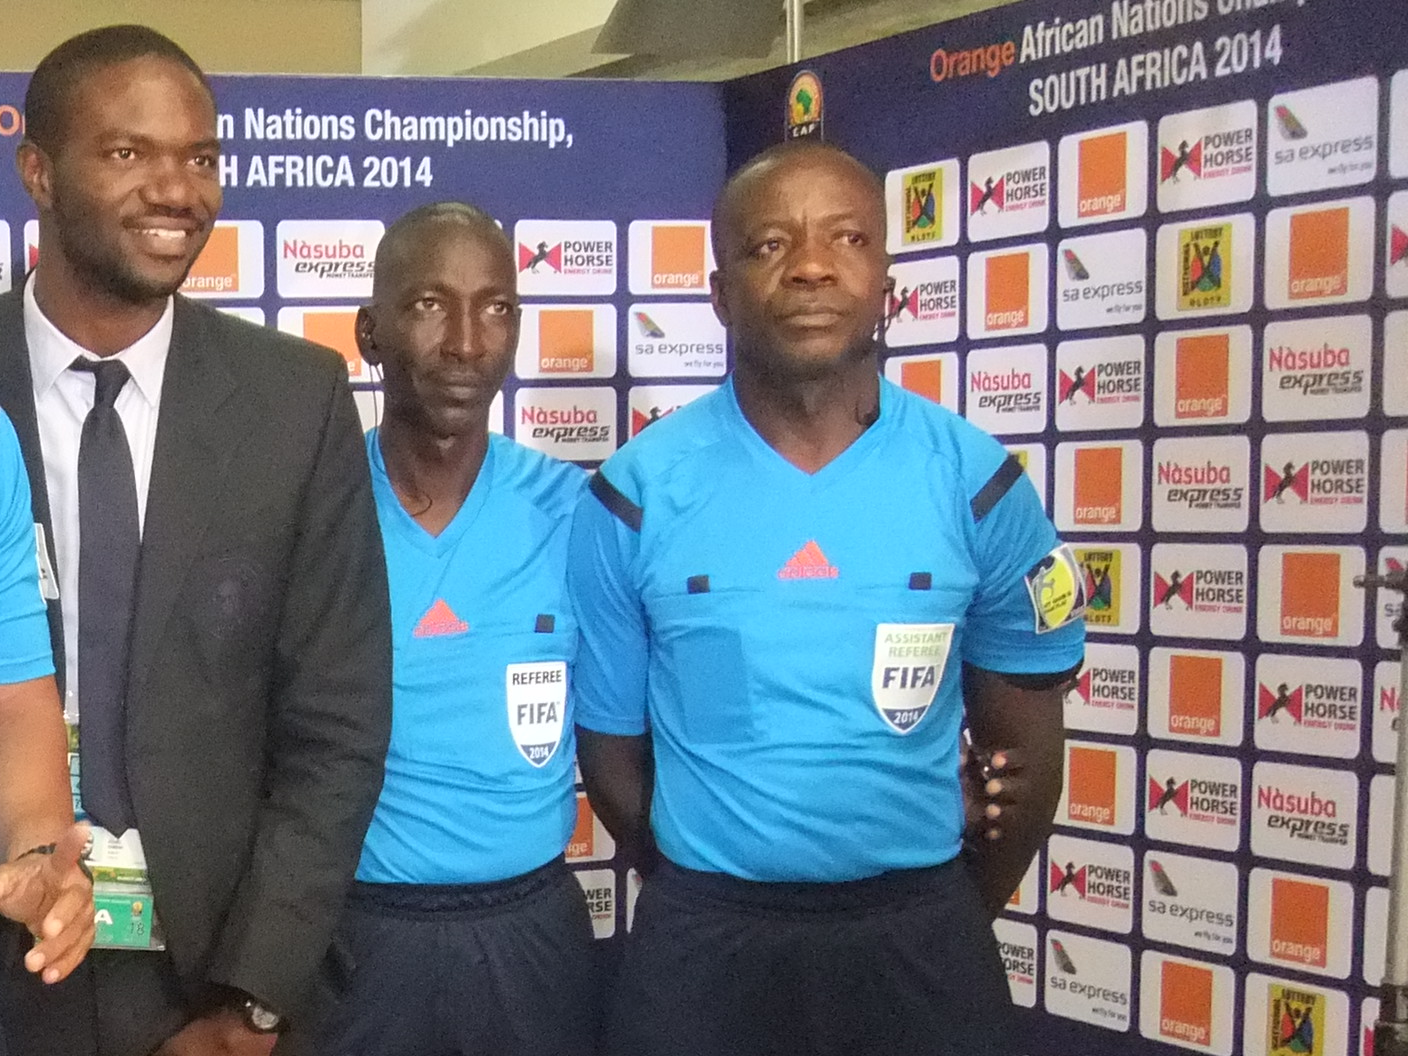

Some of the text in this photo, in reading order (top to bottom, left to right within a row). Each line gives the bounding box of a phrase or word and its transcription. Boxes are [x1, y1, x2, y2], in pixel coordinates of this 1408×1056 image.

[930, 41, 1016, 82] Orange
[1019, 14, 1104, 63] African
[1029, 24, 1283, 116] SOUTH AFRICA 2014
[245, 108, 574, 148] Nations Championship,
[793, 122, 815, 138] CAF
[1203, 127, 1253, 150] POWER
[1203, 146, 1253, 168] HORSE
[1274, 135, 1373, 165] sa express
[246, 155, 434, 188] AFRICA 2014
[1005, 166, 1047, 186] POWER
[1005, 183, 1047, 202] HORSE
[1079, 193, 1122, 213] orange
[283, 239, 365, 260] Nàsuba
[563, 241, 613, 254] POWER
[563, 255, 613, 267] HORSE
[653, 272, 700, 288] orange
[919, 279, 957, 296] POWER
[1291, 275, 1341, 294] orange
[1062, 279, 1143, 302] sa express
[919, 295, 957, 311] HORSE
[986, 310, 1025, 327] orange
[635, 342, 724, 356] sa express
[1268, 343, 1350, 373] Nàsuba
[541, 356, 588, 371] orange
[1097, 360, 1142, 377] POWER
[971, 368, 1032, 393] Nàsuba
[1097, 377, 1142, 394] HORSE
[1279, 369, 1364, 395] express
[978, 391, 1042, 413] express
[1177, 397, 1223, 415] orange
[520, 405, 598, 425] Nàsuba
[532, 425, 610, 443] express
[1158, 460, 1231, 485] Nàsuba
[1311, 459, 1364, 475] POWER
[1310, 478, 1364, 494] HORSE
[1167, 487, 1244, 509] express
[1075, 505, 1116, 522] orange
[1195, 570, 1243, 585] POWER
[1195, 588, 1243, 603] HORSE
[1282, 615, 1332, 634] orange
[884, 632, 948, 643] ASSISTANT
[888, 646, 942, 658] REFEREE
[512, 669, 562, 686] REFEREE
[882, 666, 935, 689] FIFA
[1092, 667, 1136, 684] POWER
[1092, 684, 1136, 701] HORSE
[1305, 683, 1357, 701] POWER
[517, 701, 558, 726] FIFA
[893, 709, 921, 724] 2014
[1304, 702, 1357, 721] HORSE
[1170, 713, 1216, 735] orange
[529, 746, 549, 759] 2014
[1190, 778, 1238, 799] POWER
[1190, 796, 1238, 816] HORSE
[1257, 785, 1337, 818] Nàsuba
[1070, 802, 1111, 823] orange
[1267, 813, 1350, 839] express
[1087, 864, 1131, 885] POWER
[1087, 881, 1131, 901] HORSE
[1148, 899, 1166, 914] sa
[1169, 902, 1234, 927] express
[1272, 940, 1321, 963] orange
[1050, 974, 1128, 1006] sa express
[1161, 1017, 1206, 1042] orange
